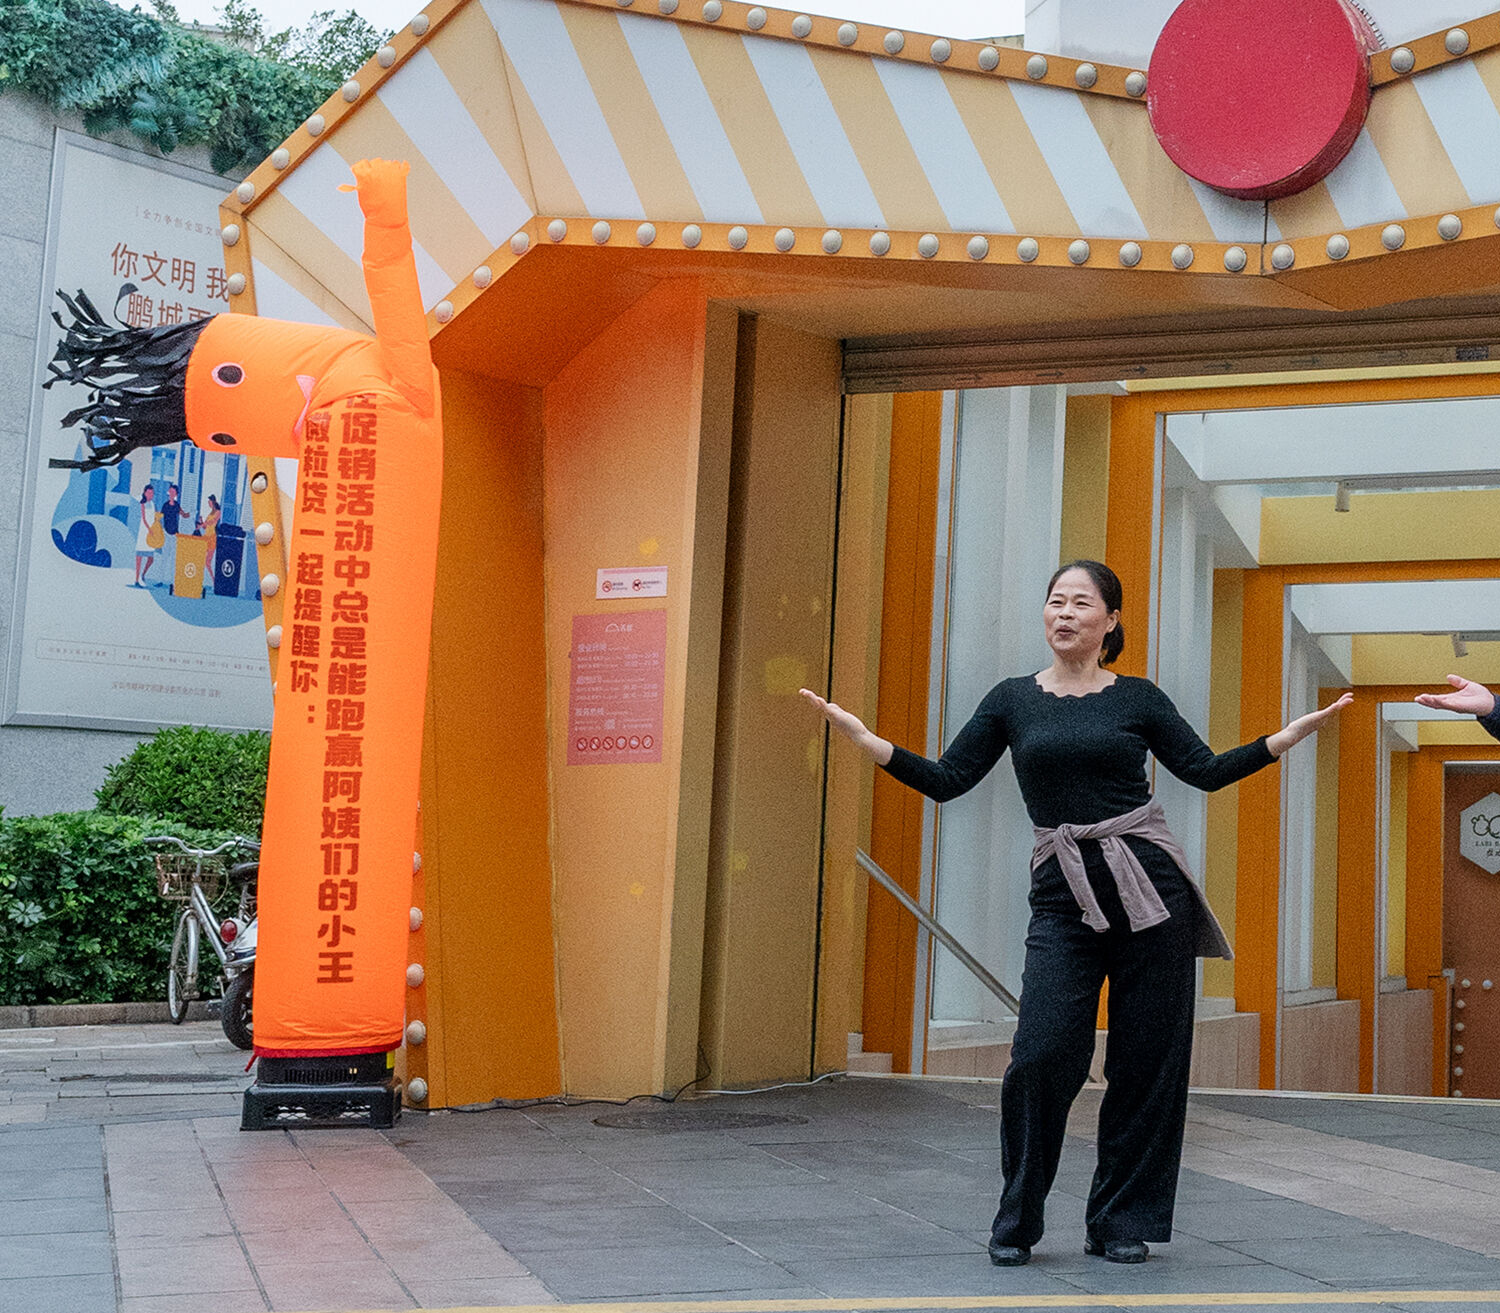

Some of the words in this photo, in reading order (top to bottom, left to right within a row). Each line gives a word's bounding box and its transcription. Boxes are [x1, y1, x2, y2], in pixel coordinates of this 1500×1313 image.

[111, 242, 196, 294] 你文明
[206, 267, 229, 303] 我
